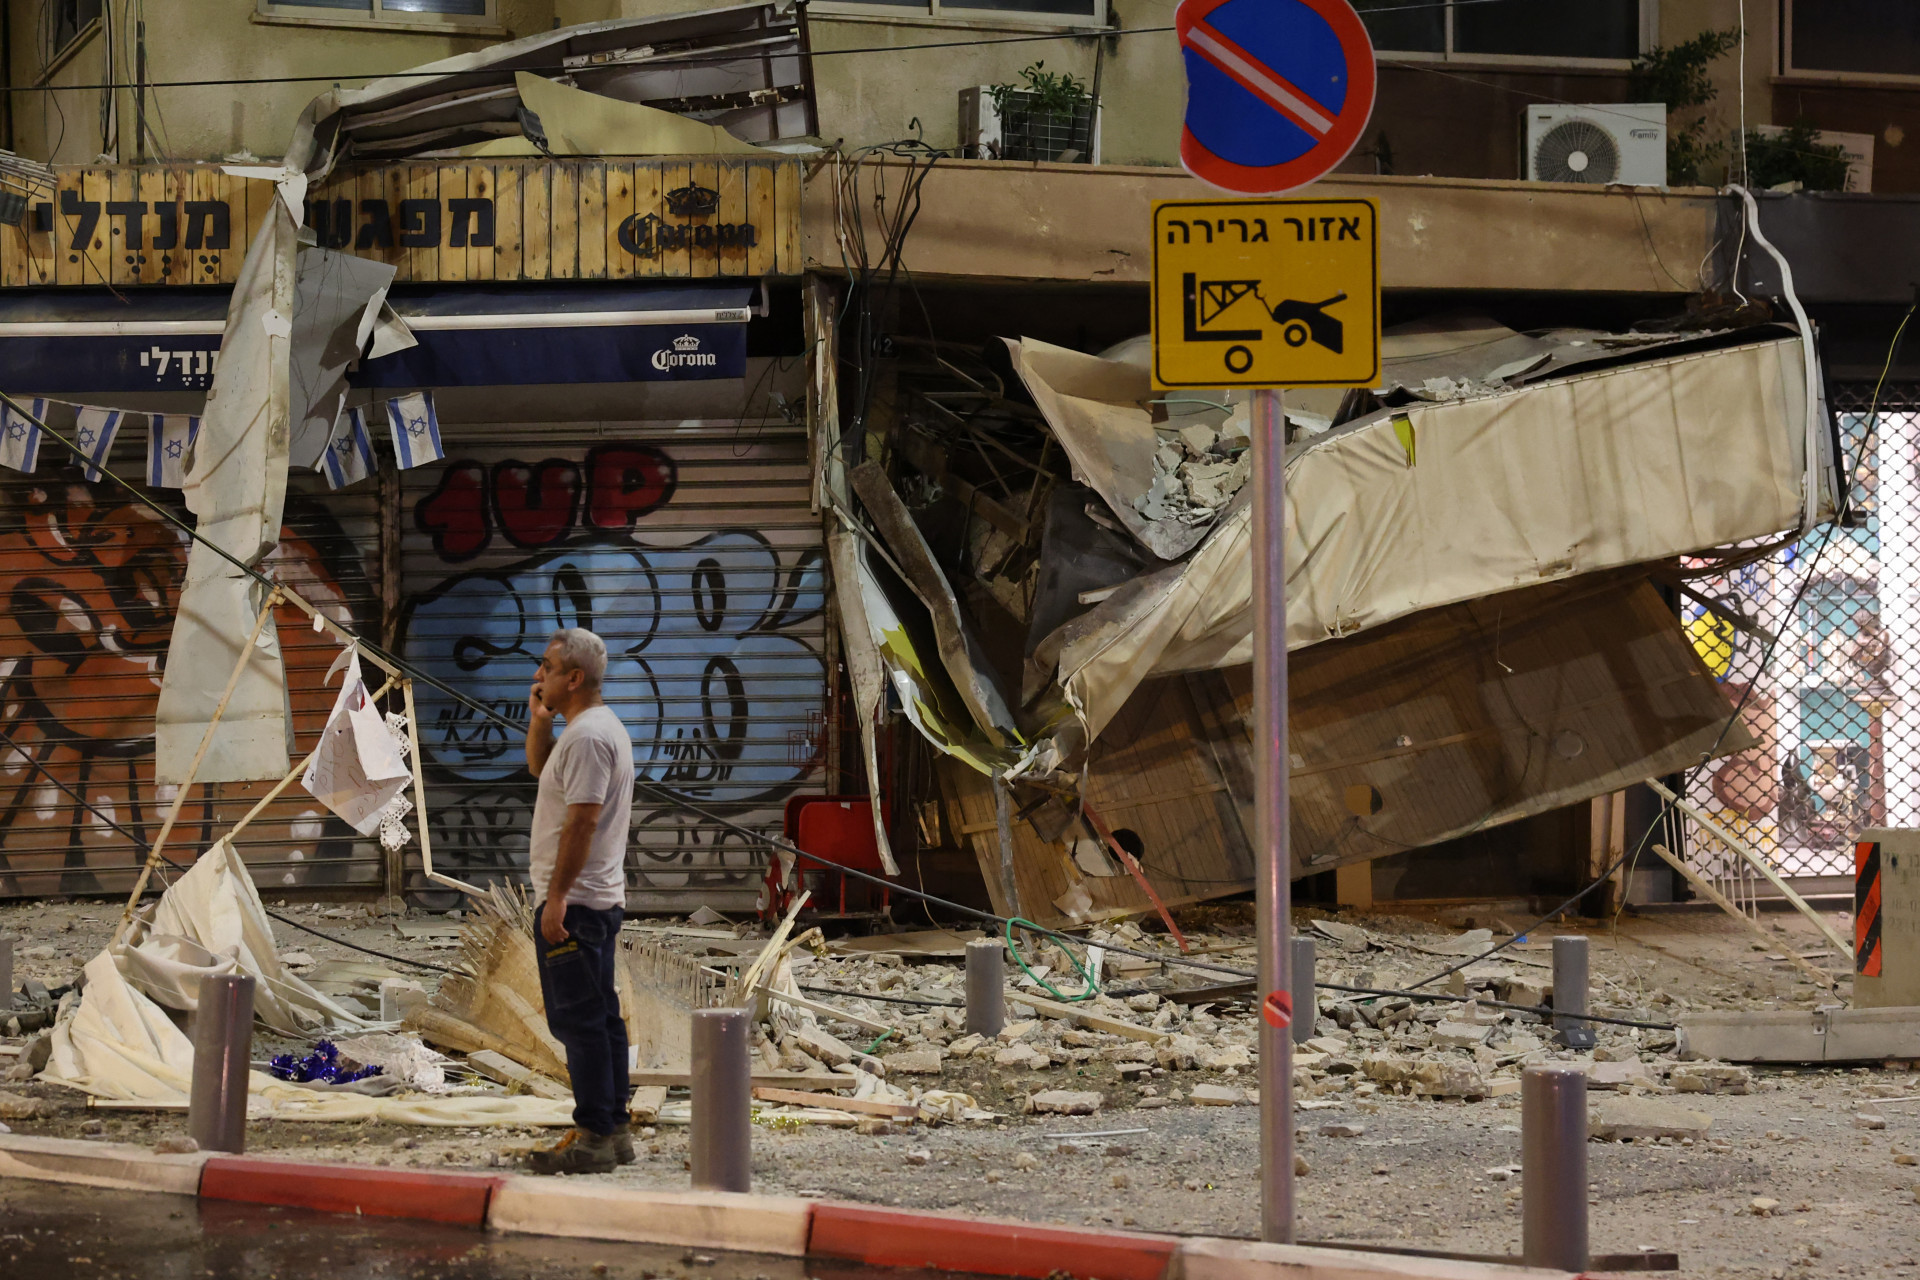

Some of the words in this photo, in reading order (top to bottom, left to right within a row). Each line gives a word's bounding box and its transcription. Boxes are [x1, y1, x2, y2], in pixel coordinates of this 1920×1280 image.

[302, 198, 494, 250] מפגש
[618, 212, 757, 257] Corona
[1167, 218, 1269, 244] גרירה
[1283, 217, 1361, 242] אזור
[652, 350, 717, 373] Corona
[414, 443, 678, 564] 1UP
